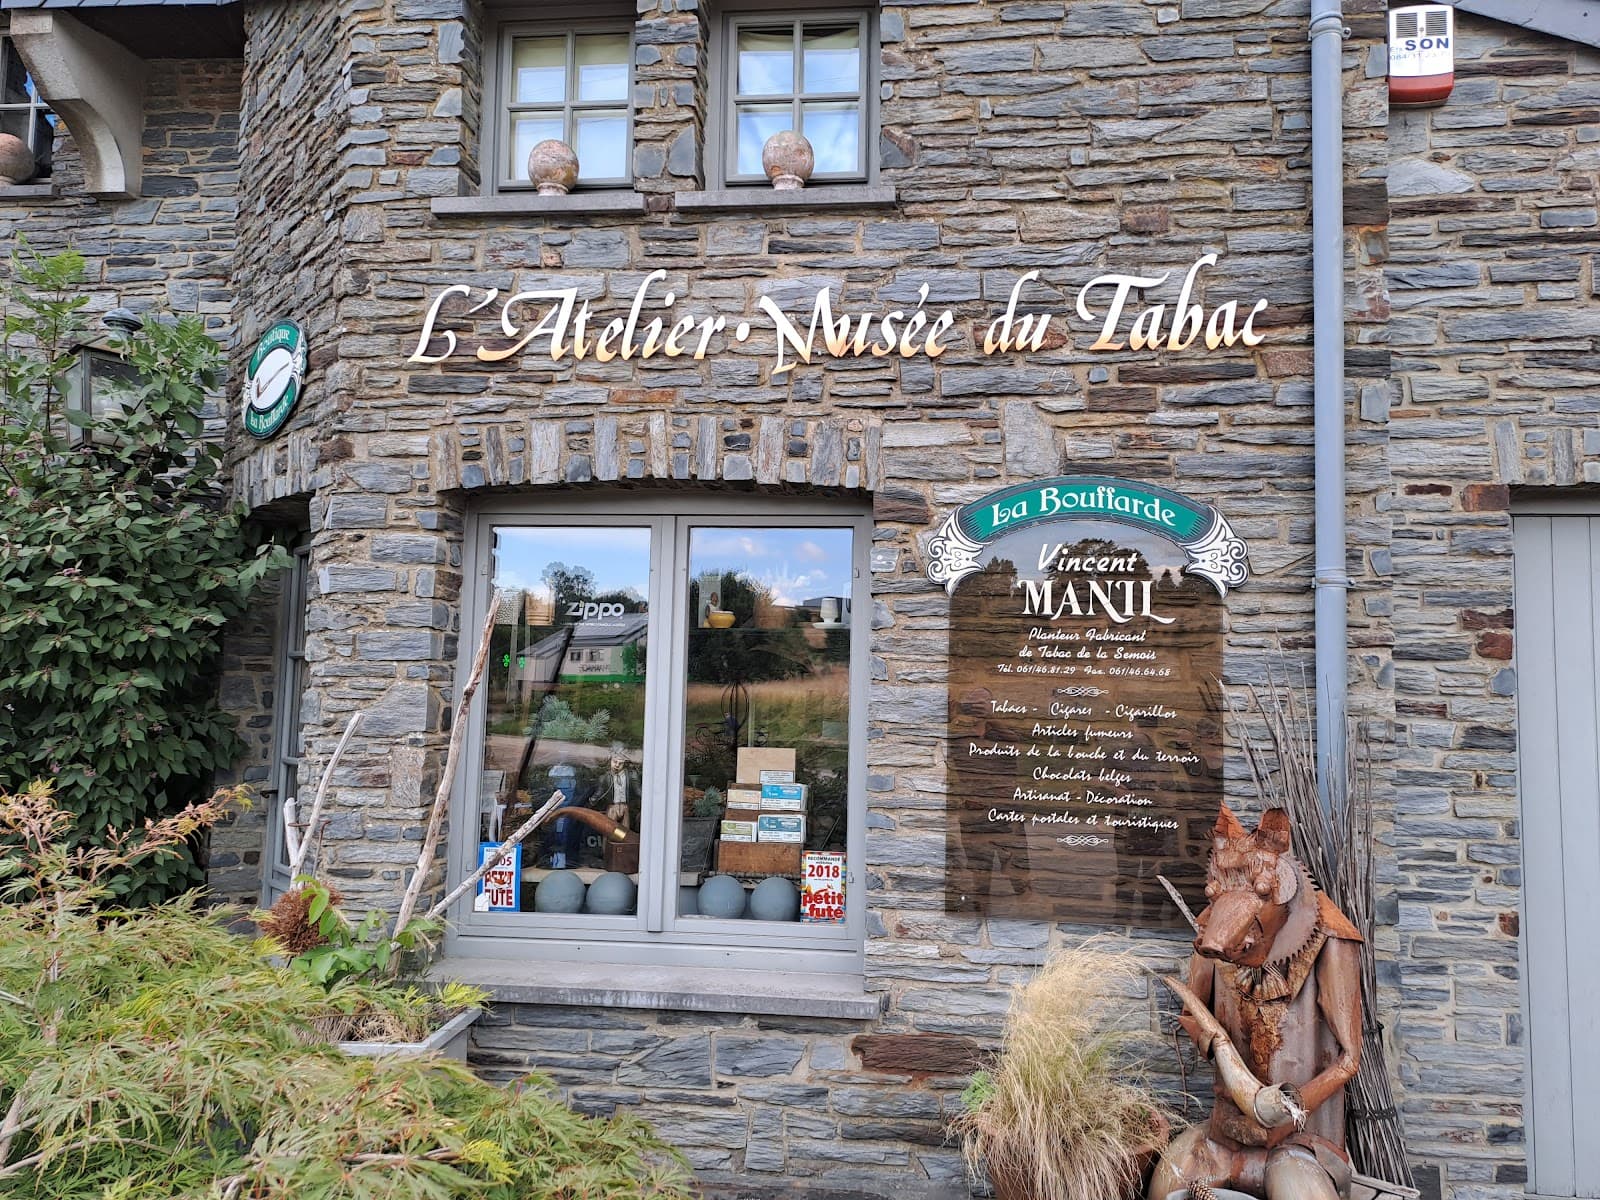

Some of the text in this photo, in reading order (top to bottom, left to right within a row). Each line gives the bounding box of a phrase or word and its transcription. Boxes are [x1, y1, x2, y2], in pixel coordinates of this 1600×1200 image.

[407, 269, 725, 363] L'Atelier
[758, 281, 954, 375] Musée
[983, 269, 1052, 354] du
[1076, 253, 1268, 351] Tabac
[257, 328, 290, 361] Boutique
[250, 395, 289, 432] La Bouffarde
[991, 486, 1177, 527] La Bouffarde
[1037, 543, 1138, 573] Vincent
[1017, 579, 1177, 624] MANIL
[1028, 627, 1146, 642] Planteur Fabricant
[1018, 644, 1157, 660] de Tabac de la Semois
[1016, 664, 1076, 675] 061/46.81.29
[1109, 666, 1172, 677] 061/46.64.68
[990, 699, 1028, 714] Tabacs
[1050, 701, 1093, 719] Cigares
[1115, 703, 1178, 721] Cigarillos
[1031, 722, 1134, 742] Articles fumeurs
[968, 742, 1201, 764] Produits de la bouche et du terroir
[1032, 766, 1132, 786] Chocolats belges
[1013, 786, 1071, 802] Artisanat
[1086, 790, 1153, 806] Décoration
[987, 808, 1180, 834] Cartes postales et touristiques
[808, 864, 839, 878] 2018
[802, 891, 844, 906] petit
